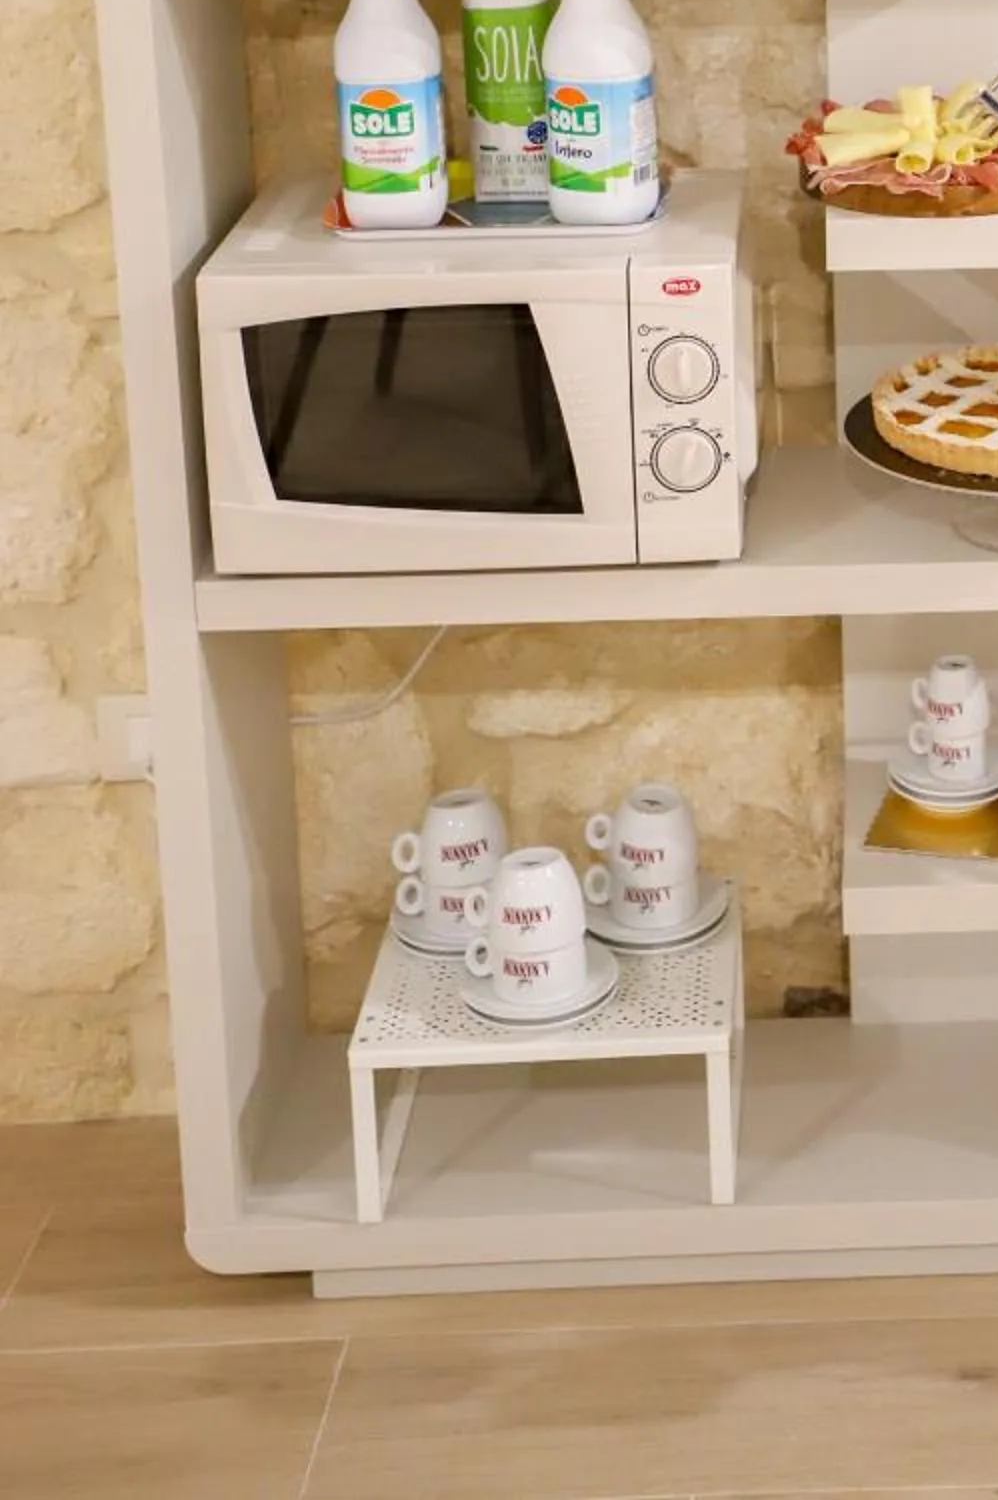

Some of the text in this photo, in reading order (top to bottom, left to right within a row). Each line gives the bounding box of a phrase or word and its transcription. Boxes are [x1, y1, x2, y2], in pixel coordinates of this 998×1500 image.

[474, 24, 542, 83] SOIA
[353, 111, 411, 134] SOLE
[550, 108, 597, 133] SOLE
